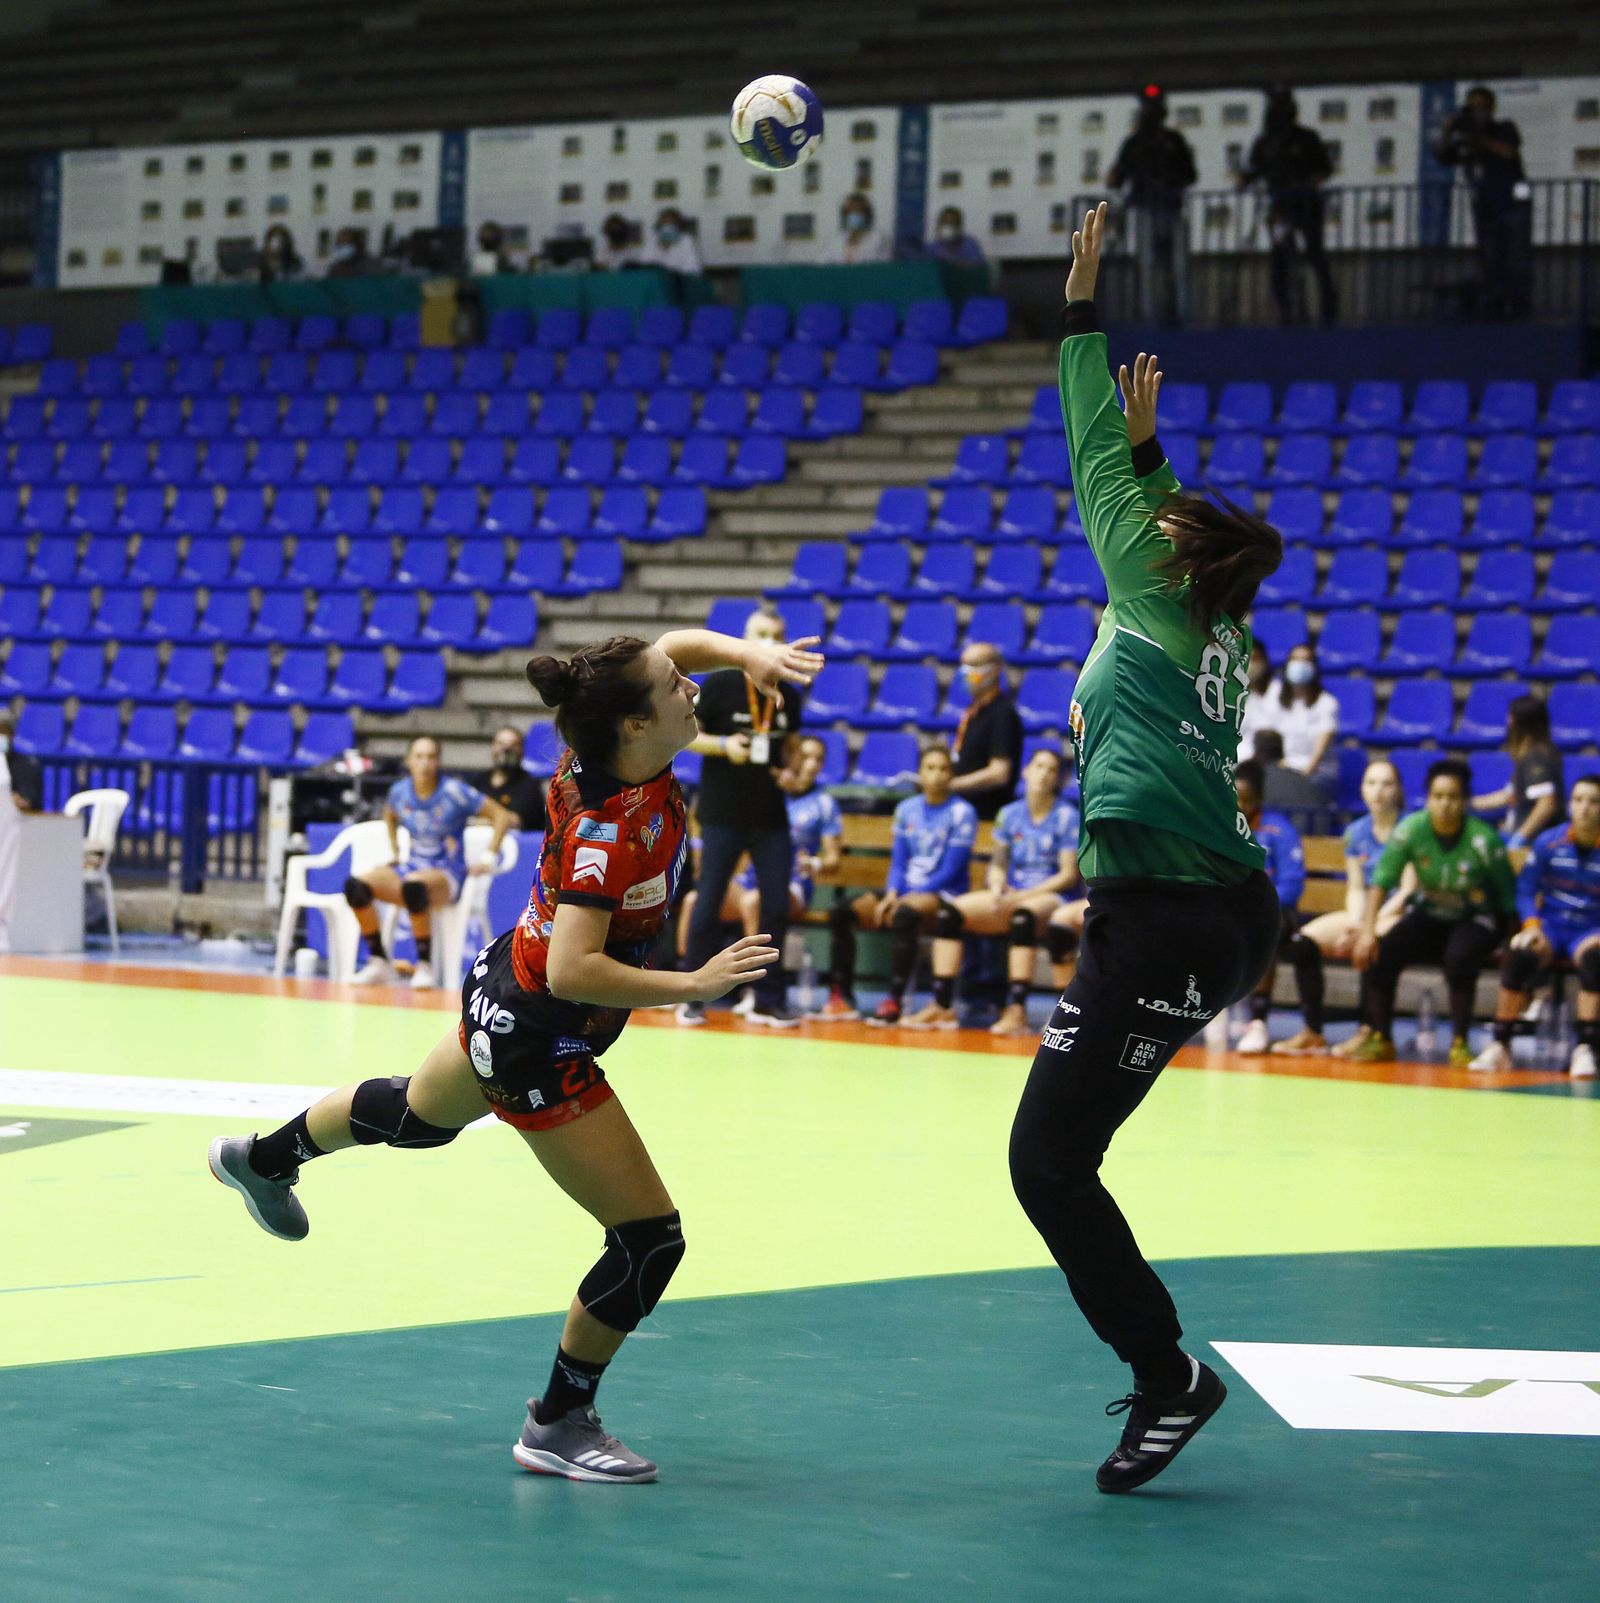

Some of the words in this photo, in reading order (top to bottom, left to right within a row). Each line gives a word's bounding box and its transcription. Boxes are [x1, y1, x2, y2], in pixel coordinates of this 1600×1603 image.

[1145, 999, 1214, 1020] David
[1137, 1041, 1156, 1053] ARA
[1133, 1048, 1156, 1060] MEN
[1130, 1056, 1148, 1067] DIA
